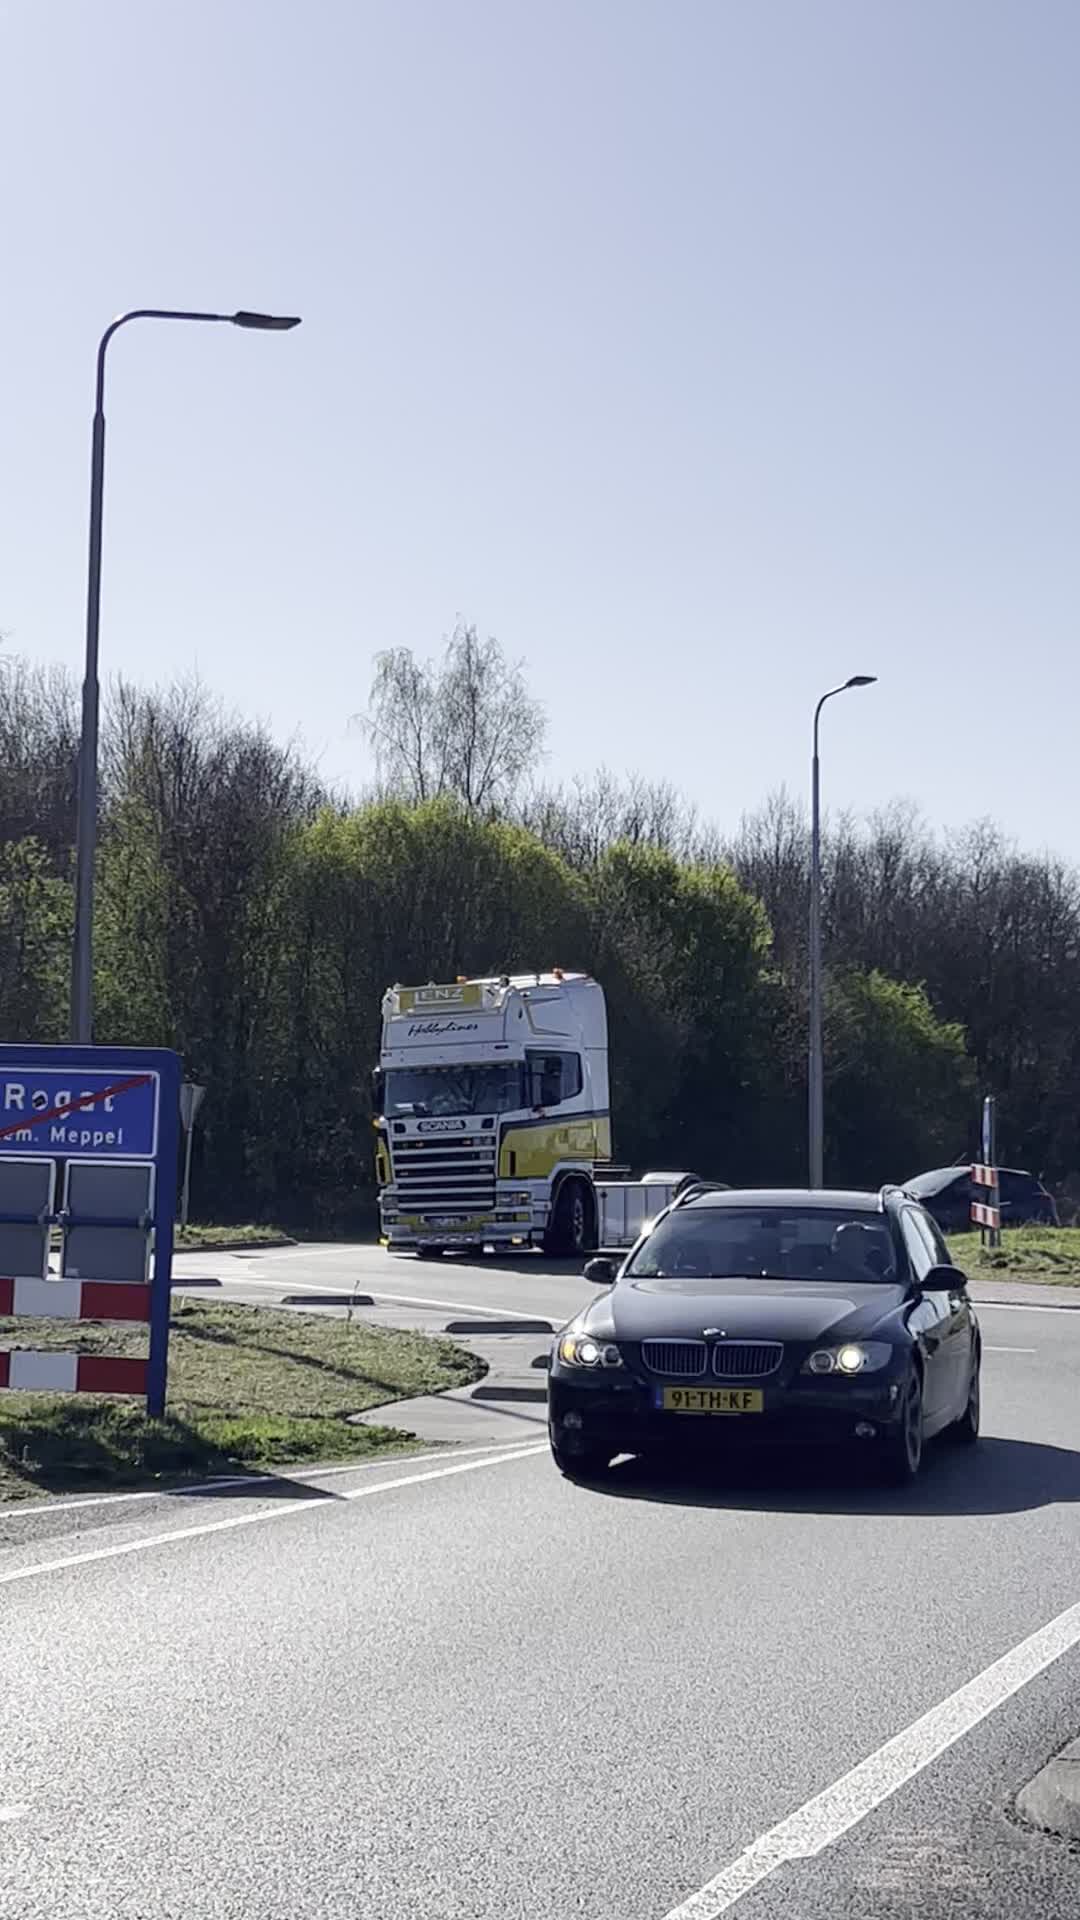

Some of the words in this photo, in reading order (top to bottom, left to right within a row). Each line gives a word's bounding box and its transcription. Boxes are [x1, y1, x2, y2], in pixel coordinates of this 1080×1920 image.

[5, 1083, 115, 1119] Rogat
[420, 1119, 463, 1130] SCANIA
[50, 1126, 123, 1146] Meppel
[671, 1390, 753, 1409] 91-TH-KF
